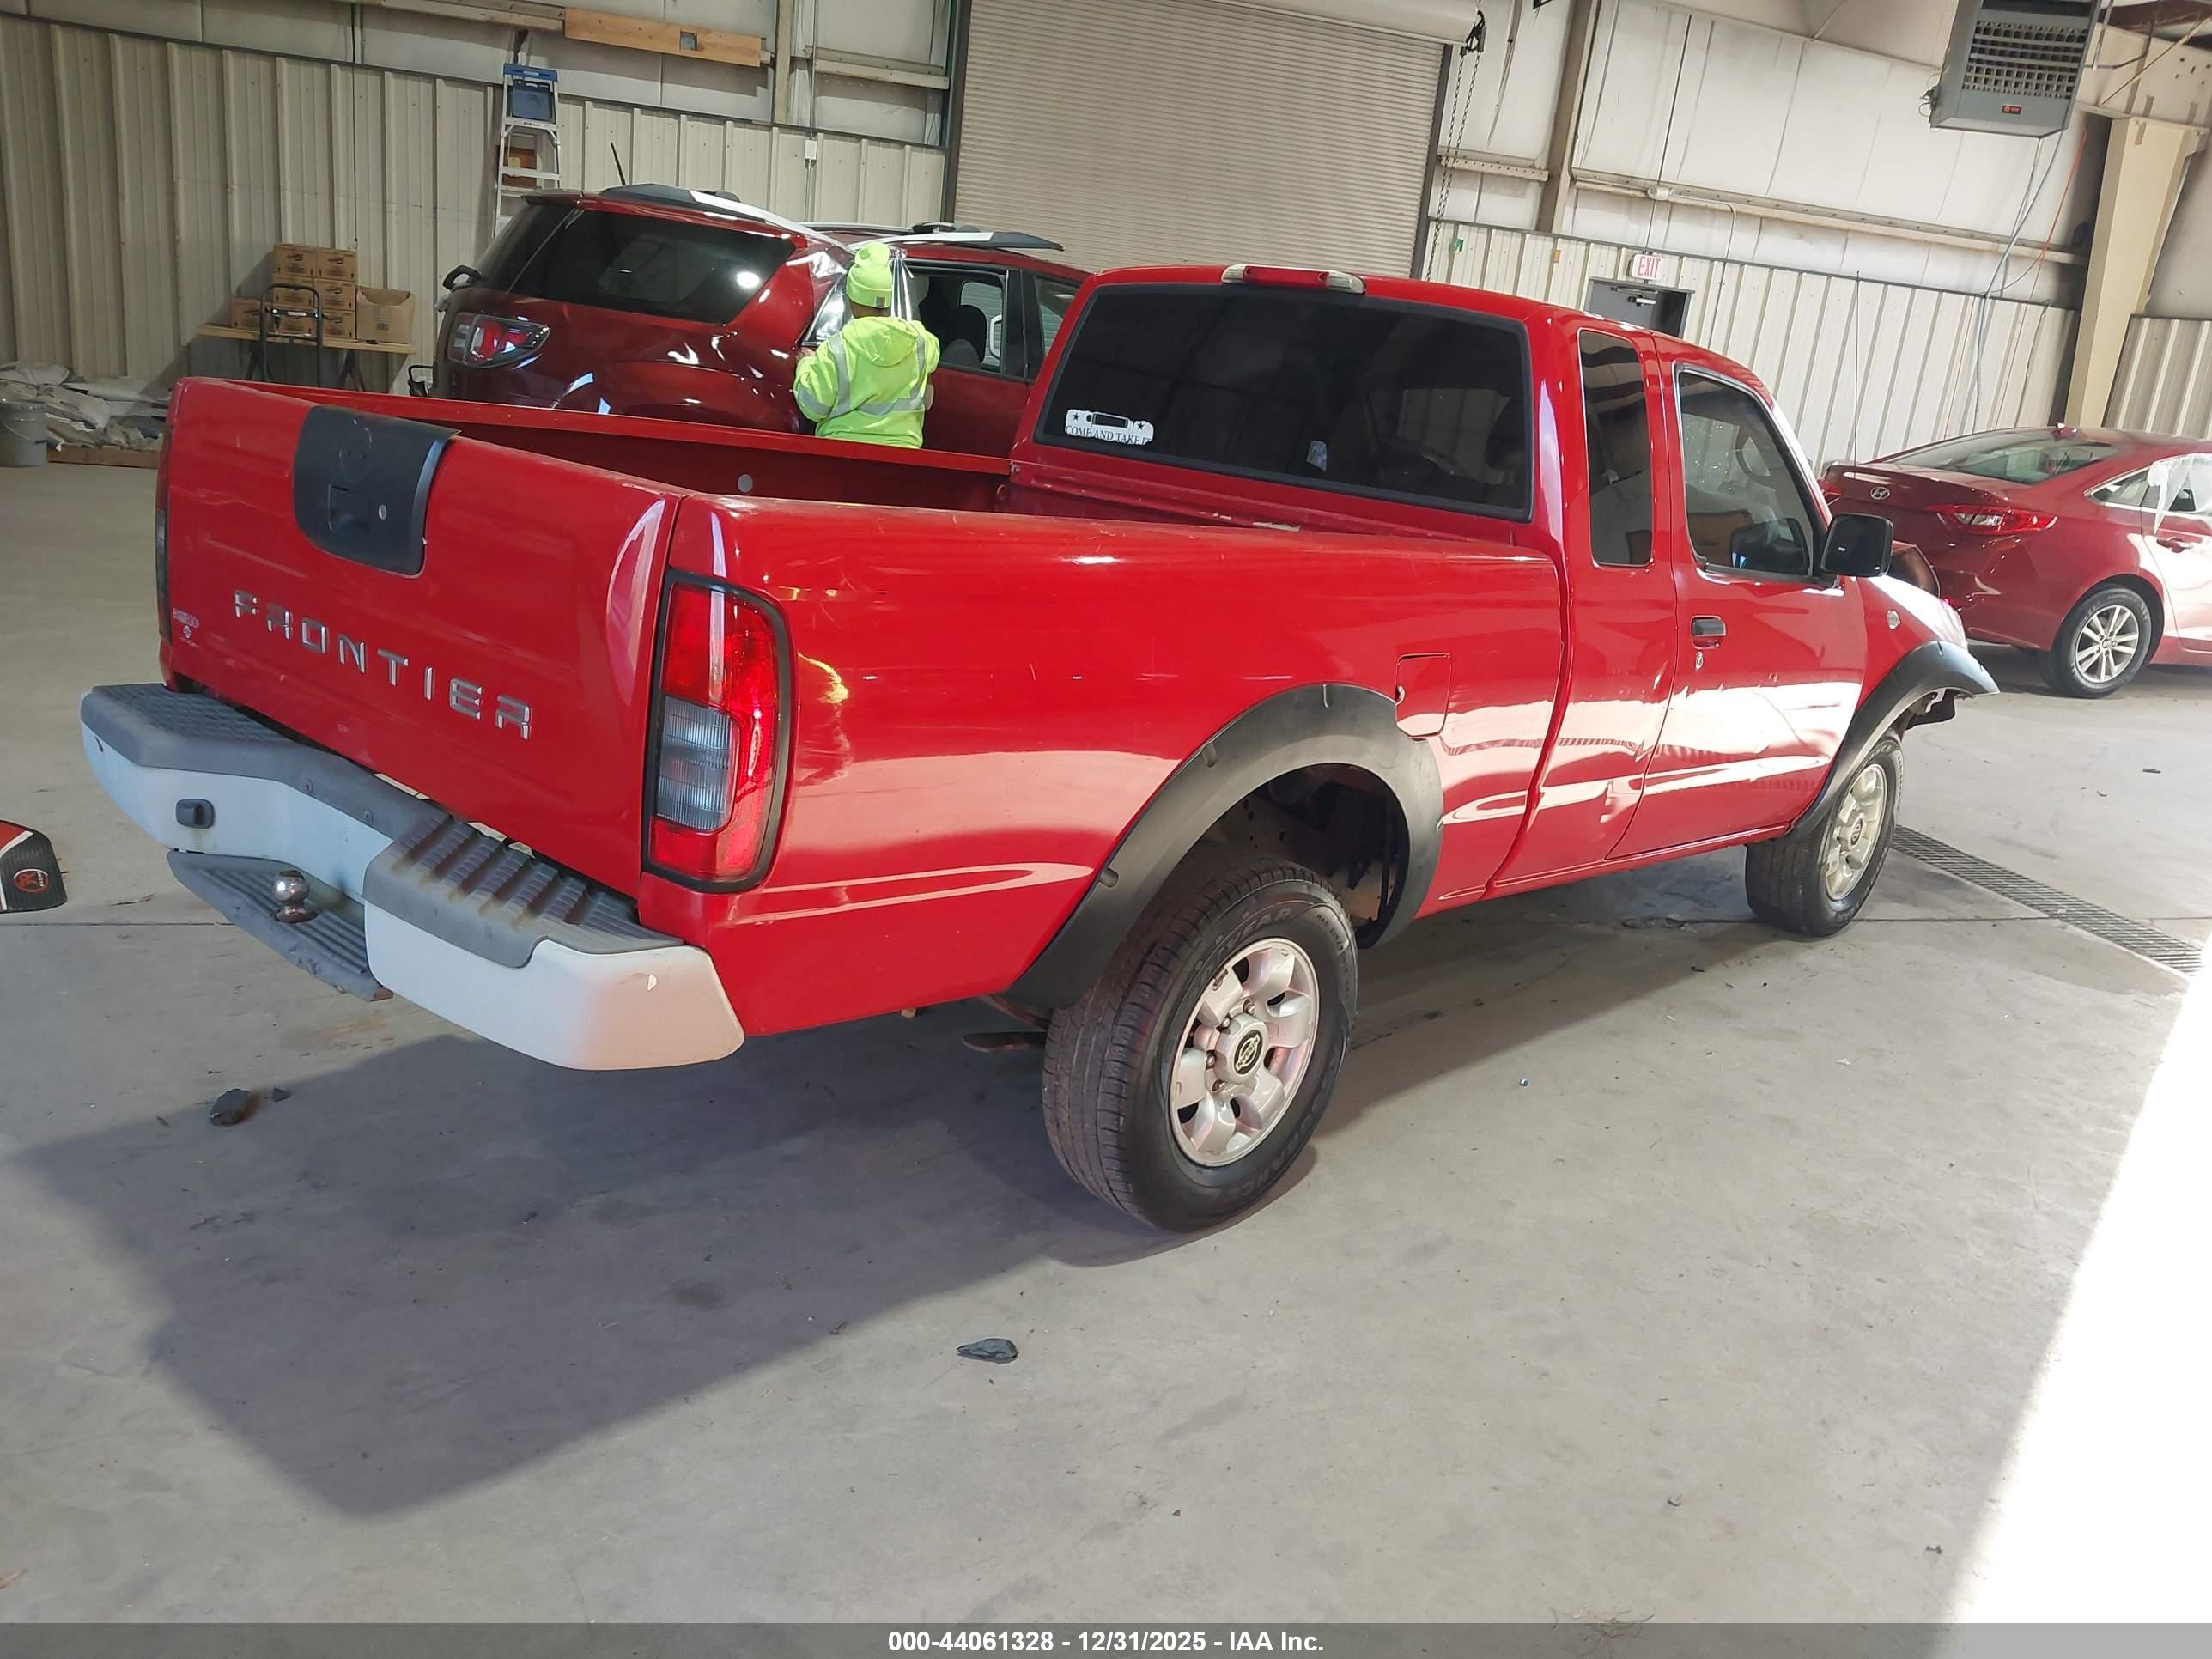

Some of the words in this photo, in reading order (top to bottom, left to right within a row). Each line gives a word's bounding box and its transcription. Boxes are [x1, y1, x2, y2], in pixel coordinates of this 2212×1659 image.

[1638, 256, 1661, 278] EXIT
[1065, 426, 1091, 437] COME
[1094, 429, 1114, 441] AND
[1115, 432, 1139, 444] TAKE
[234, 589, 532, 740] FRONTIER
